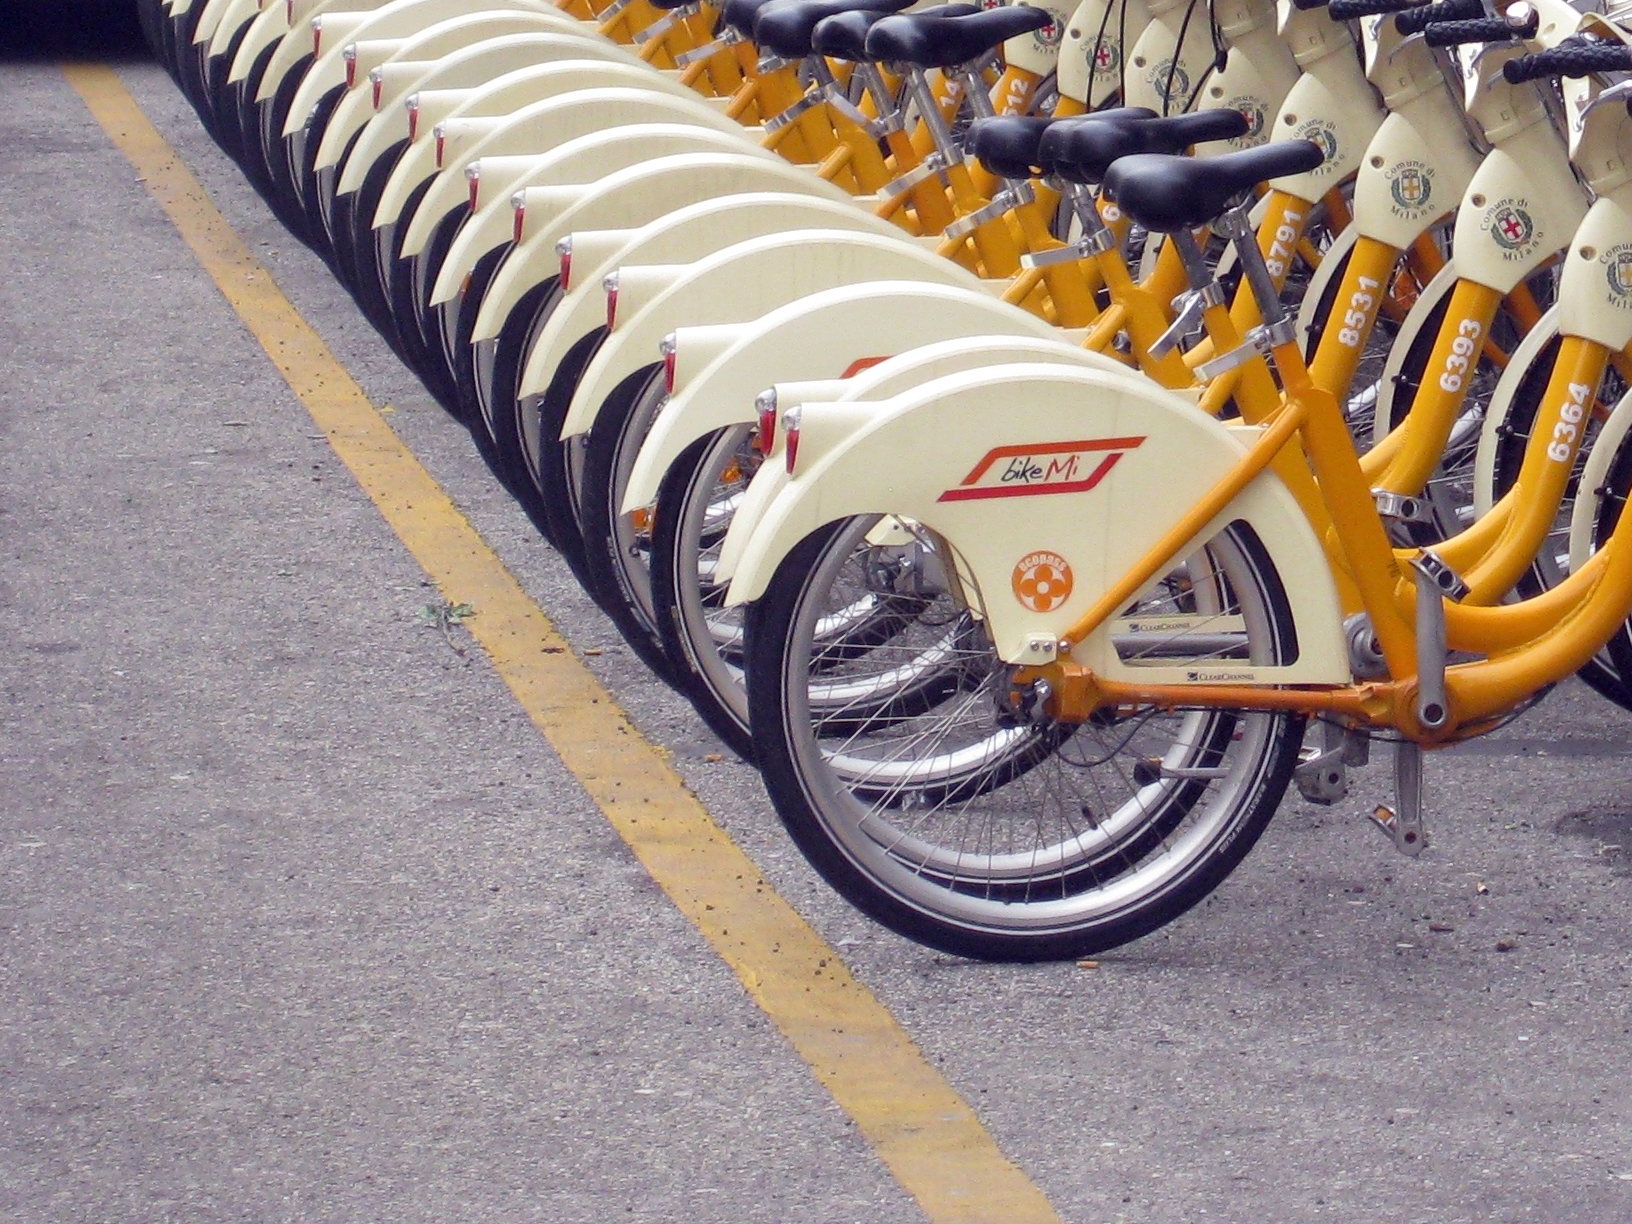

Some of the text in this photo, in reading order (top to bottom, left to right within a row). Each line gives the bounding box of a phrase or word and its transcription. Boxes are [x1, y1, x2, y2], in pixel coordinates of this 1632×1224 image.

[1310, 154, 1344, 176] ilano
[1385, 161, 1425, 179] Comune
[1391, 203, 1435, 220] Milano
[1480, 198, 1528, 231] Comune di
[1266, 210, 1301, 276] 8791
[1503, 231, 1544, 261] Milano
[1338, 276, 1379, 347] 8531
[1439, 318, 1482, 392] 6393
[1547, 382, 1591, 462] 6364
[1001, 456, 1081, 483] bikeMi
